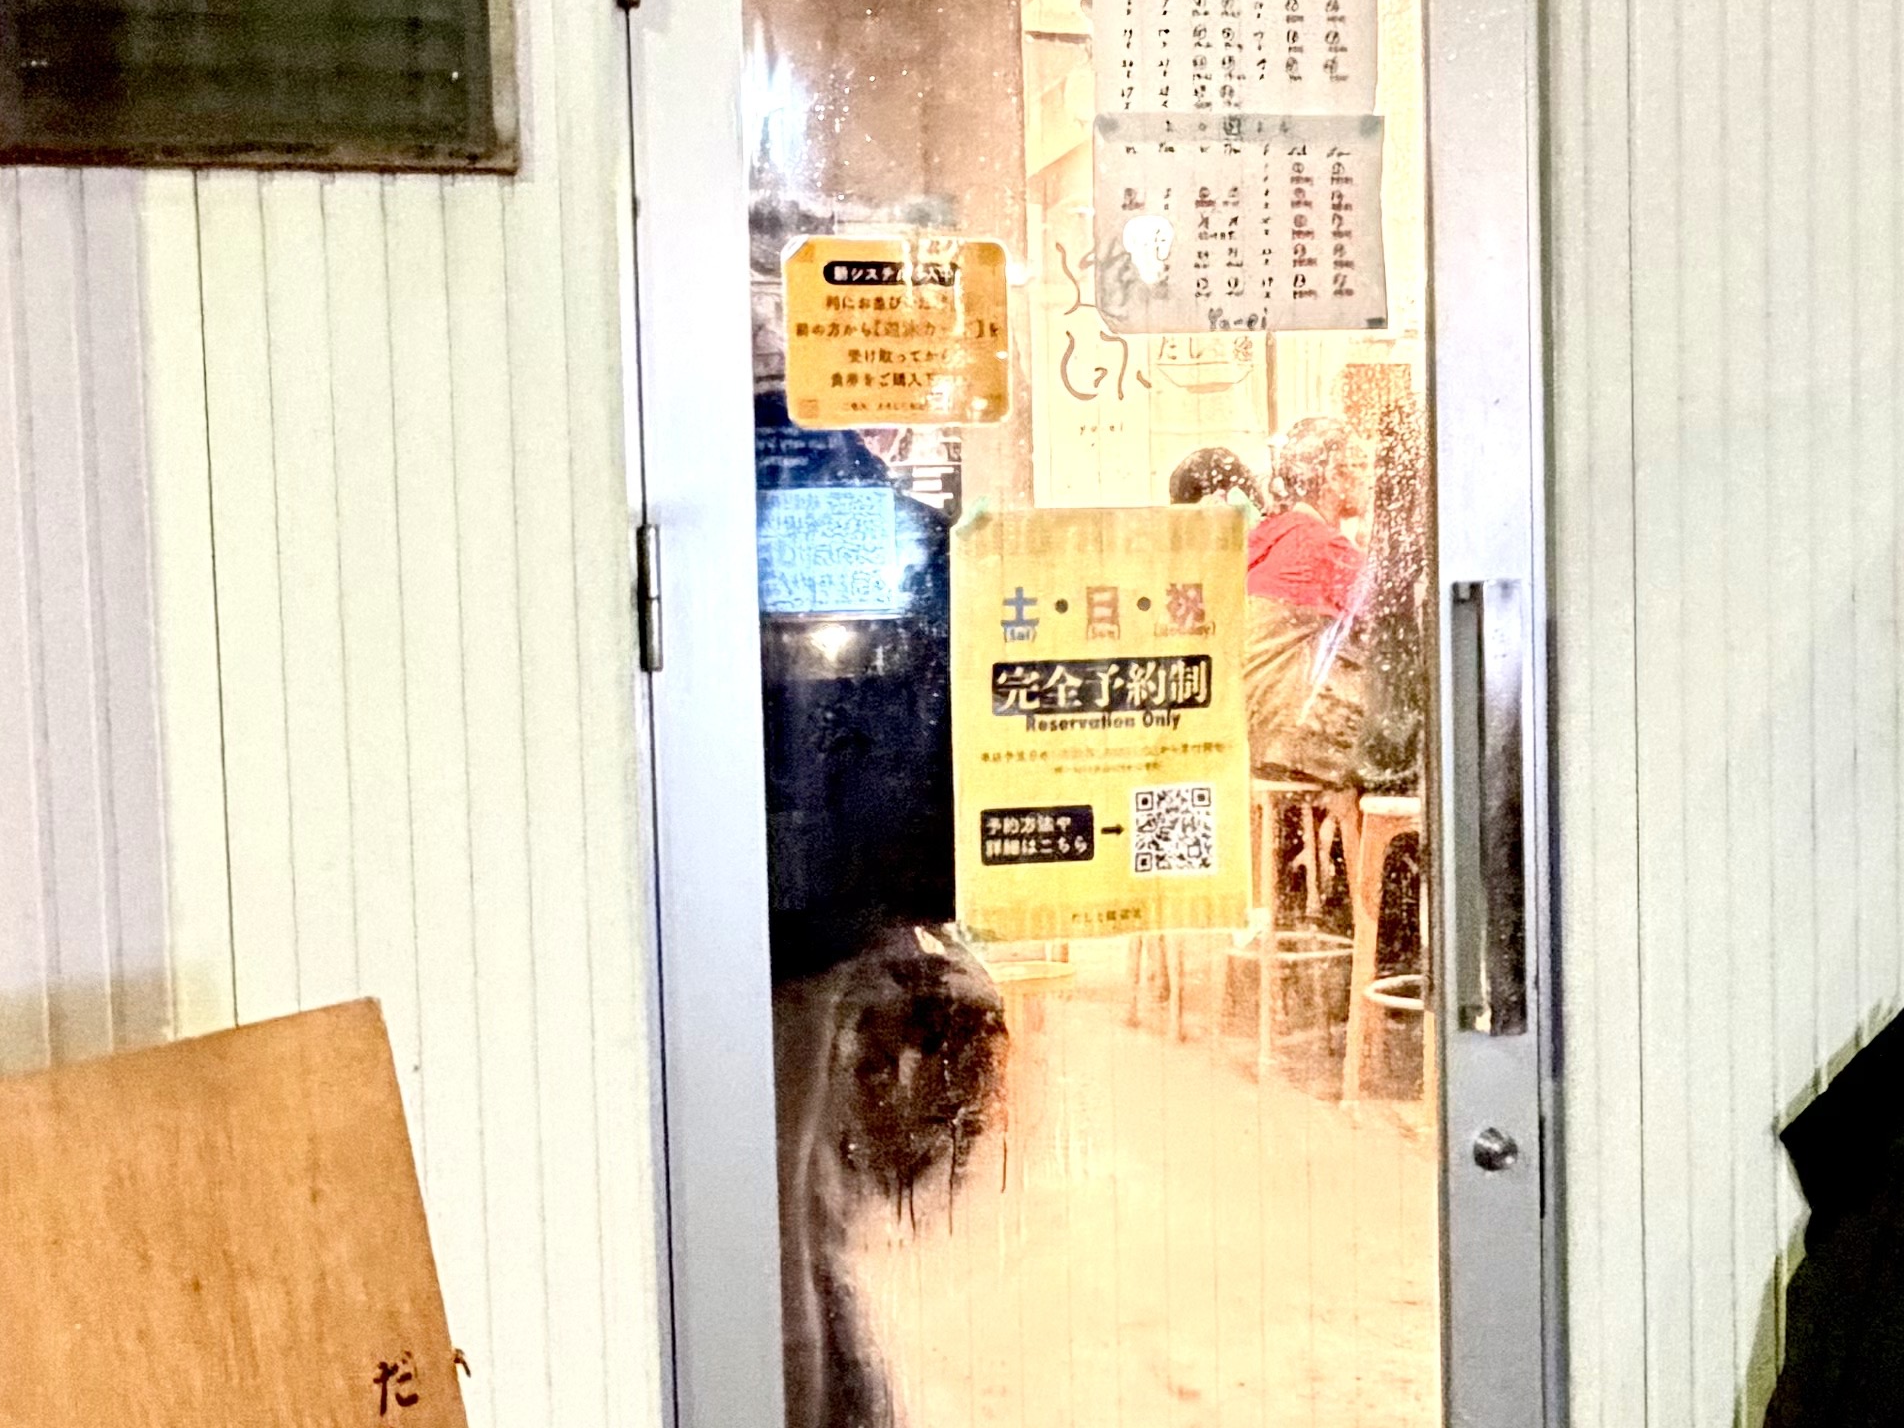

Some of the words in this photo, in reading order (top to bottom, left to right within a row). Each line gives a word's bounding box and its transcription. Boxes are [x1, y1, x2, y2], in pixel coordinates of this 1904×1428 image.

[996, 659, 1210, 712] 完全予約制
[1025, 711, 1136, 733] Reservation
[1141, 707, 1182, 732] Only
